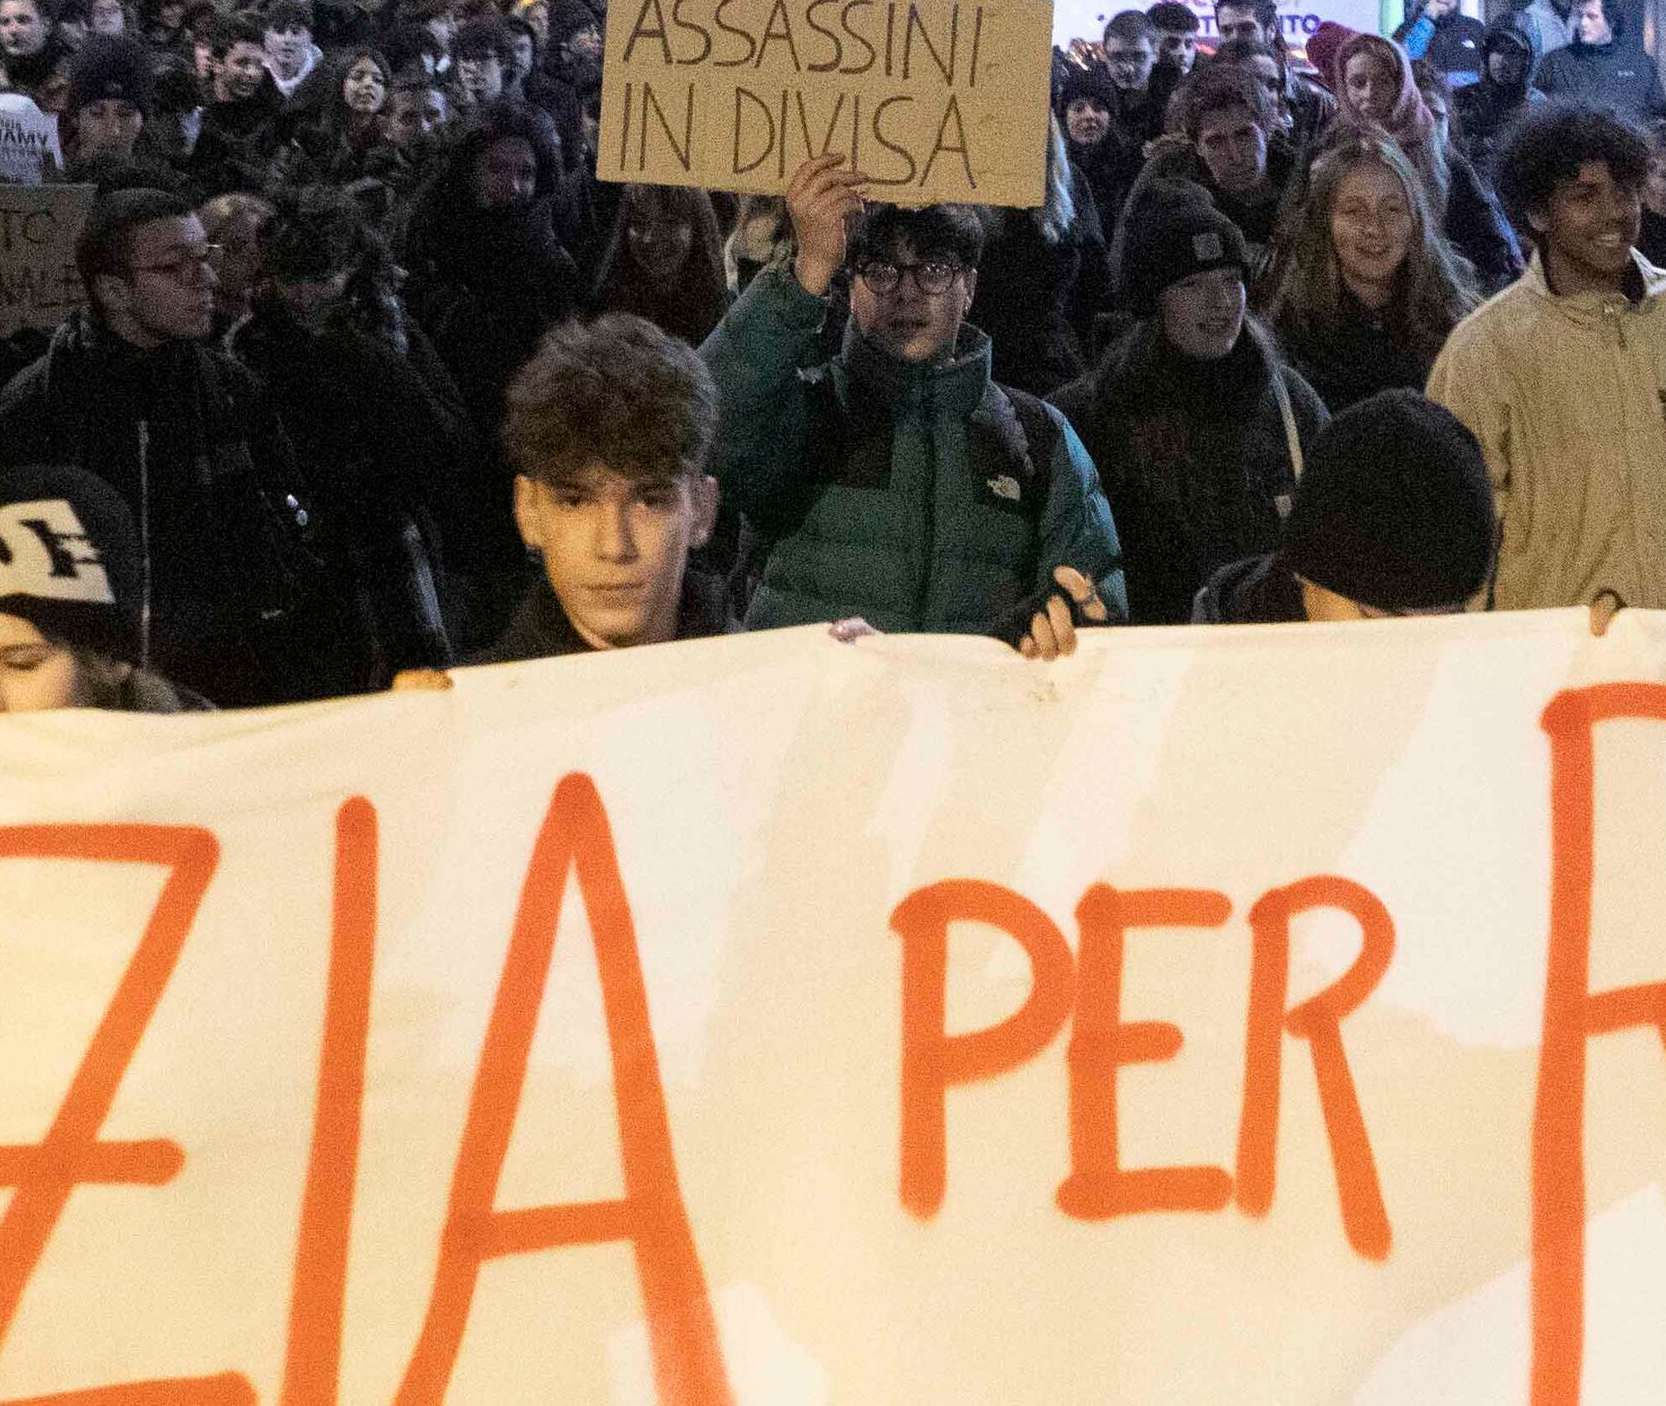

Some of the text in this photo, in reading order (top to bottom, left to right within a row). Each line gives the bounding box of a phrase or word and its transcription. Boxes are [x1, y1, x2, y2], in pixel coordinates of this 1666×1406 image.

[619, 81, 978, 190] IN DIVISA
[890, 876, 1394, 1259] PER
